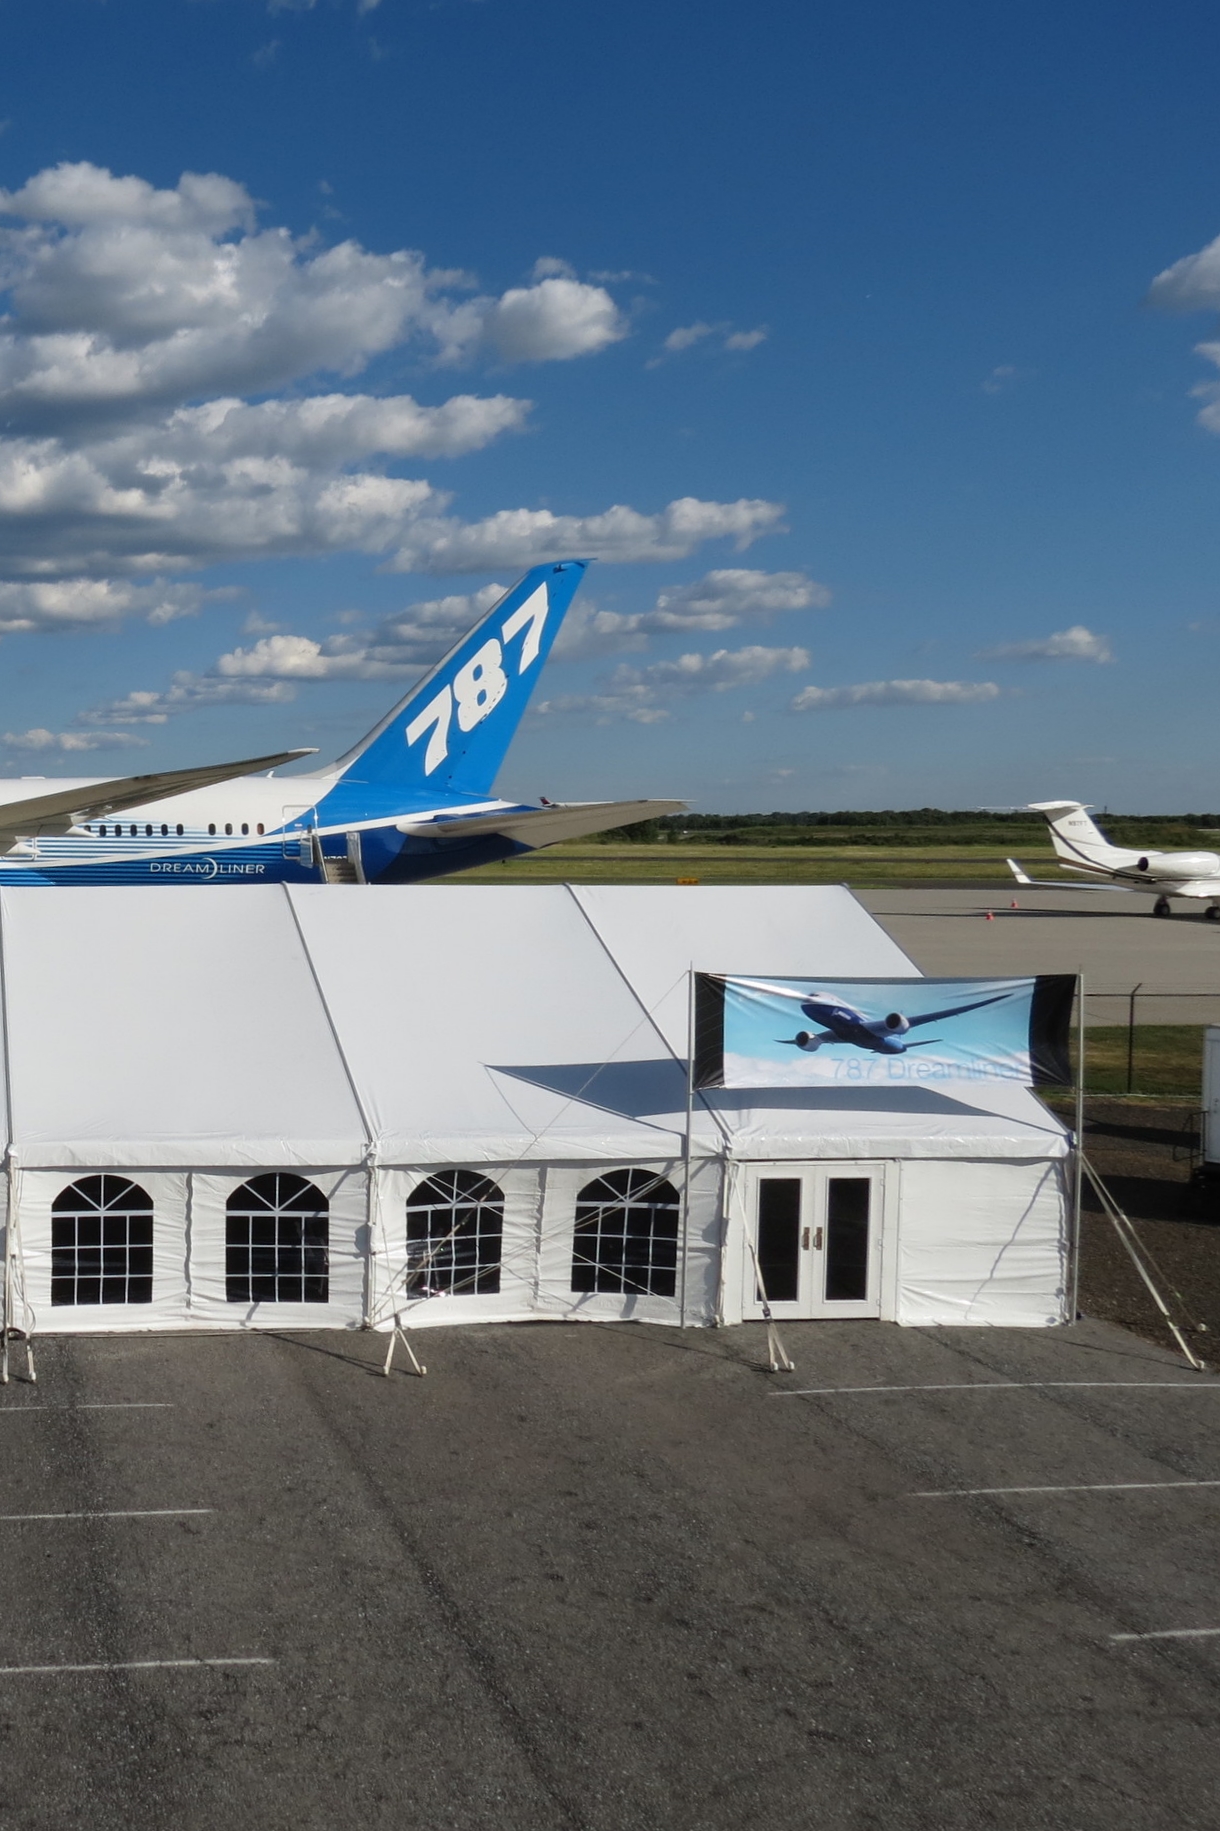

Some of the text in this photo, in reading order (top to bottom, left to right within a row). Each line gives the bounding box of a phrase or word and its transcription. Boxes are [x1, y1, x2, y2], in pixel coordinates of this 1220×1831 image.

[406, 581, 548, 776] 787
[831, 1057, 1024, 1079] 787 Dreamliner
